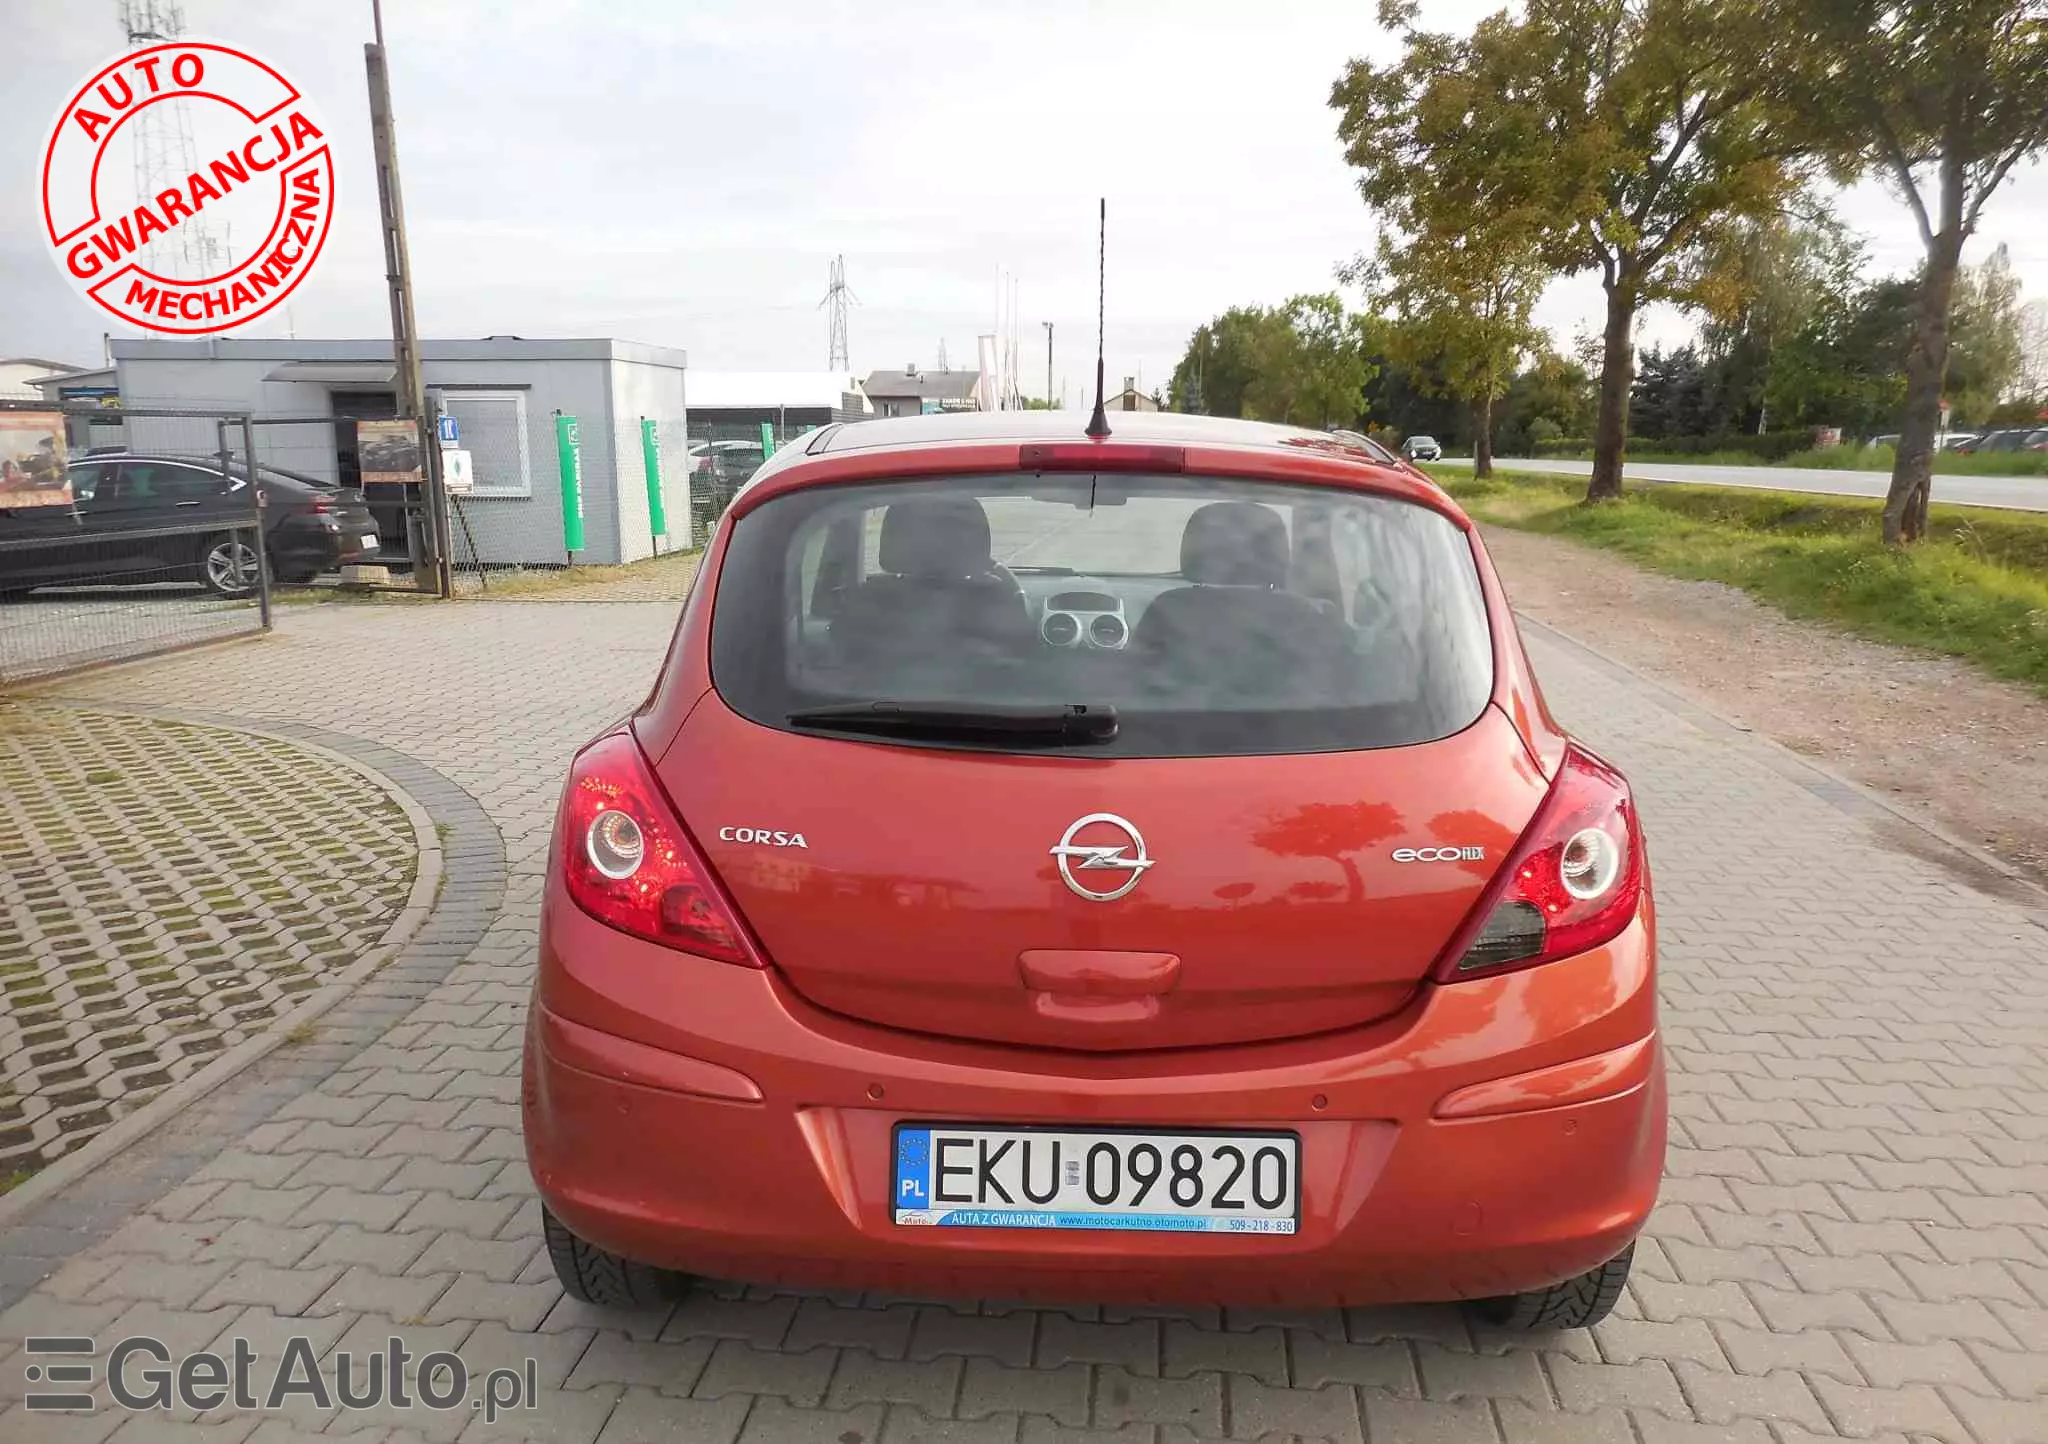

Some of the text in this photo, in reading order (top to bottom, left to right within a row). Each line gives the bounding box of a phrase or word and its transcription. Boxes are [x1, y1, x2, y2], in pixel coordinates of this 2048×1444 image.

[719, 826, 809, 849] CORSA
[935, 1137, 1288, 1210] EKU 09820
[901, 1178, 925, 1197] PL
[951, 1213, 1056, 1227] AUTA Z GWARANCJA
